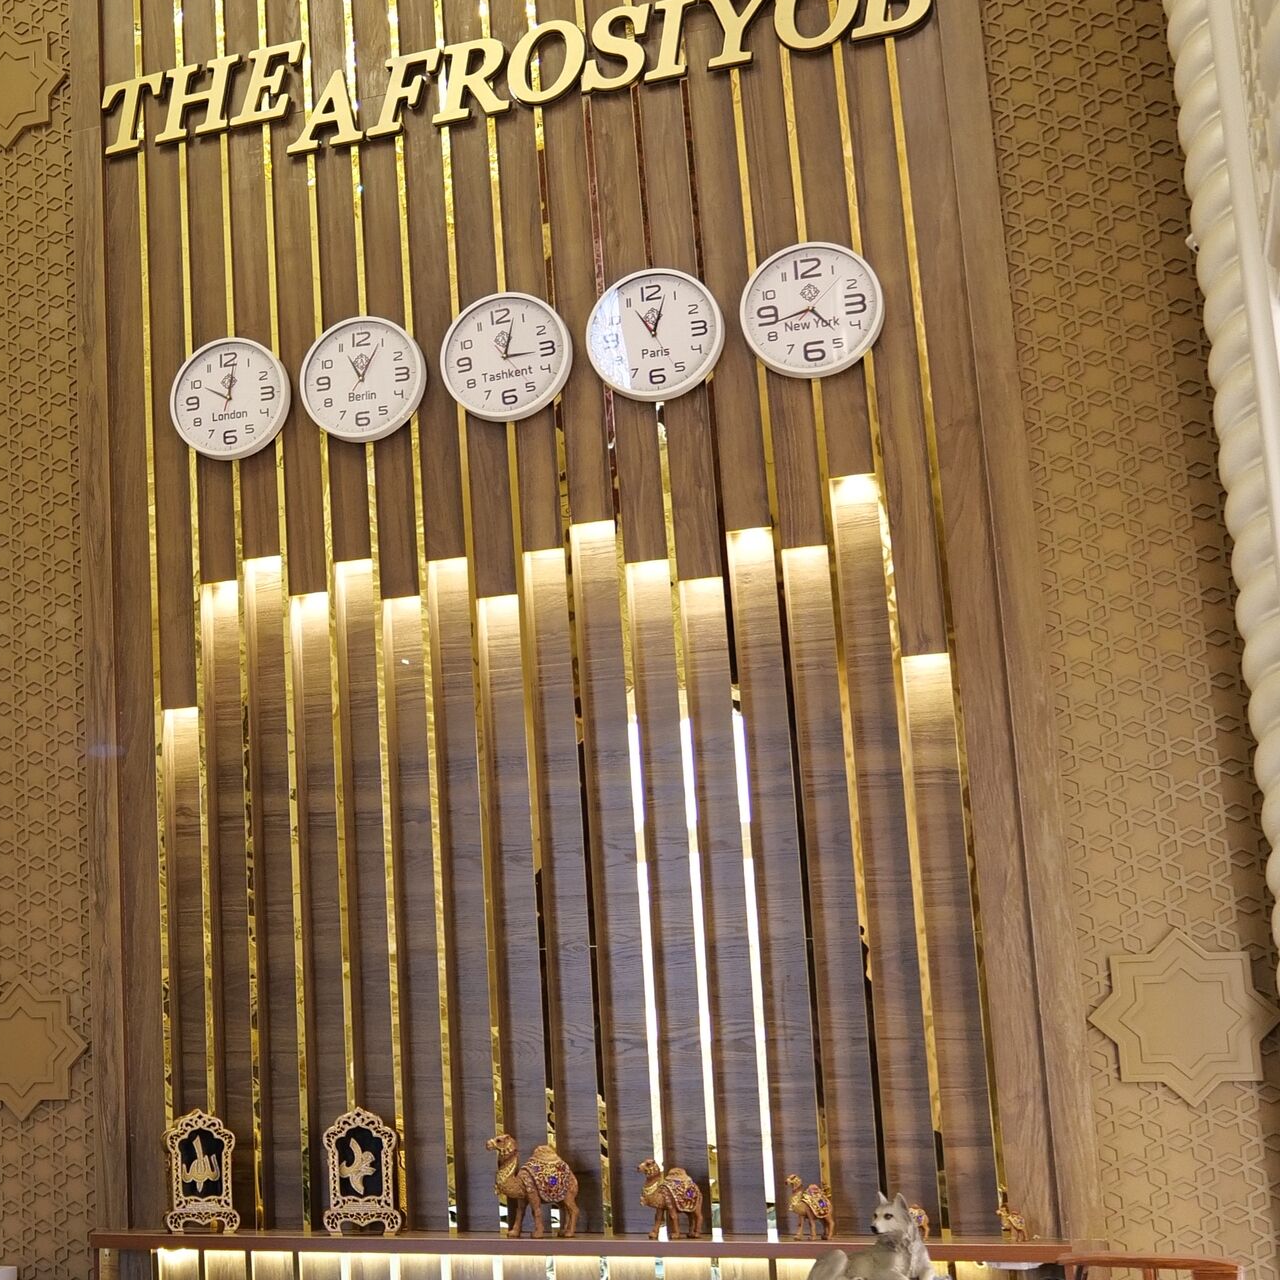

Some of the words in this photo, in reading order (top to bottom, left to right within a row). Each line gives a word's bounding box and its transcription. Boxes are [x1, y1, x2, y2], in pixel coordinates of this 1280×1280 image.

[102, 40, 305, 157] THE
[793, 258, 822, 280] 12
[847, 279, 857, 289] 2
[641, 285, 661, 302] 12
[763, 290, 775, 301] 10
[688, 304, 698, 314] 2
[844, 293, 867, 315] 3
[490, 308, 510, 325] 12
[757, 305, 778, 327] 9
[691, 320, 708, 336] 3
[785, 321, 810, 332] New
[813, 316, 839, 328] York
[850, 320, 861, 329] 4
[536, 325, 546, 336] 2
[768, 331, 778, 341] 8
[352, 331, 371, 348] 12
[833, 338, 843, 348] 5
[461, 340, 472, 351] 10
[539, 340, 556, 357] 3
[691, 344, 702, 353] 4
[787, 344, 795, 355] 7
[393, 351, 402, 361] 2
[642, 347, 670, 359] Paris
[804, 341, 826, 362] 6
[220, 352, 237, 368] 12
[322, 360, 333, 369] 10
[457, 357, 472, 373] 9
[540, 364, 551, 373] 4
[675, 362, 685, 372] 5
[259, 371, 268, 380] 2
[395, 367, 410, 382] 3
[482, 365, 533, 382] Tashkent
[631, 368, 638, 378] 7
[649, 368, 666, 384] 6
[191, 380, 201, 390] 10
[316, 376, 331, 392] 9
[467, 379, 476, 389] 8
[526, 382, 536, 392] 5
[261, 386, 275, 401] 3
[348, 391, 376, 402] Berlin
[394, 389, 403, 398] 4
[485, 390, 491, 400] 7
[502, 389, 518, 405] 6
[186, 396, 199, 411] 9
[324, 398, 333, 407] 8
[212, 410, 247, 421] London
[260, 408, 269, 417] 4
[340, 410, 346, 420] 7
[379, 406, 388, 415] 5
[193, 417, 202, 427] 8
[355, 411, 370, 426] 6
[208, 430, 215, 439] 7
[245, 424, 254, 434] 5
[223, 430, 237, 445] 6
